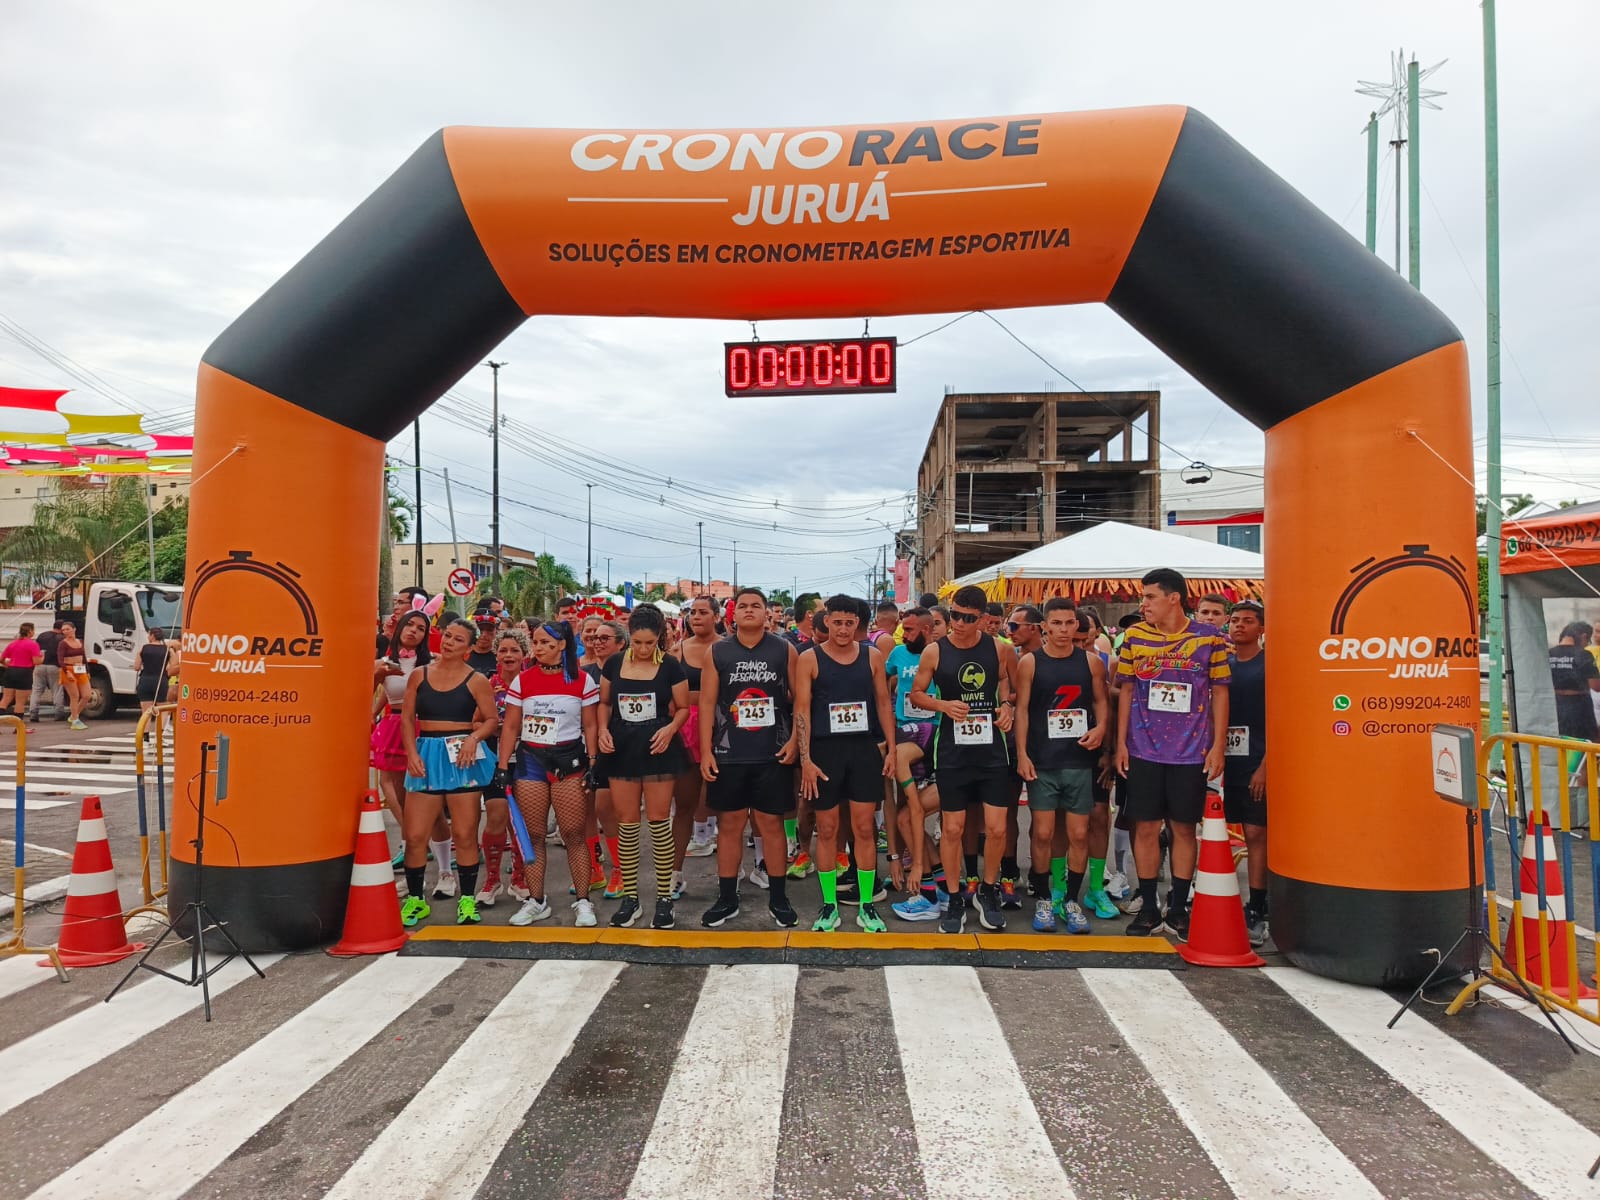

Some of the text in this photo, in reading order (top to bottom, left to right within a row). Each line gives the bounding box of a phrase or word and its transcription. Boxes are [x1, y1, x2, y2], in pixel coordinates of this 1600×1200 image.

[731, 171, 890, 226] JURUÁ
[548, 228, 1071, 268] SOLUÇÕES EM CRONOMETRAGEM ESPORTIVA
[730, 343, 891, 388] 00:00:00
[210, 657, 266, 674] JURUÁ
[736, 660, 767, 673] FRANGO
[1389, 660, 1449, 679] JURUÁ
[193, 688, 299, 703] (68)99204-2480
[961, 692, 985, 702] WAVE
[1161, 691, 1175, 703] 71
[629, 703, 642, 714] 30
[1361, 696, 1471, 712] (68)99204-2480
[192, 710, 312, 727] @cronorace.jurua
[745, 707, 765, 718] 243
[837, 712, 858, 723] 161
[528, 723, 547, 735] 179
[961, 724, 982, 735] 130
[1059, 719, 1073, 730] 39
